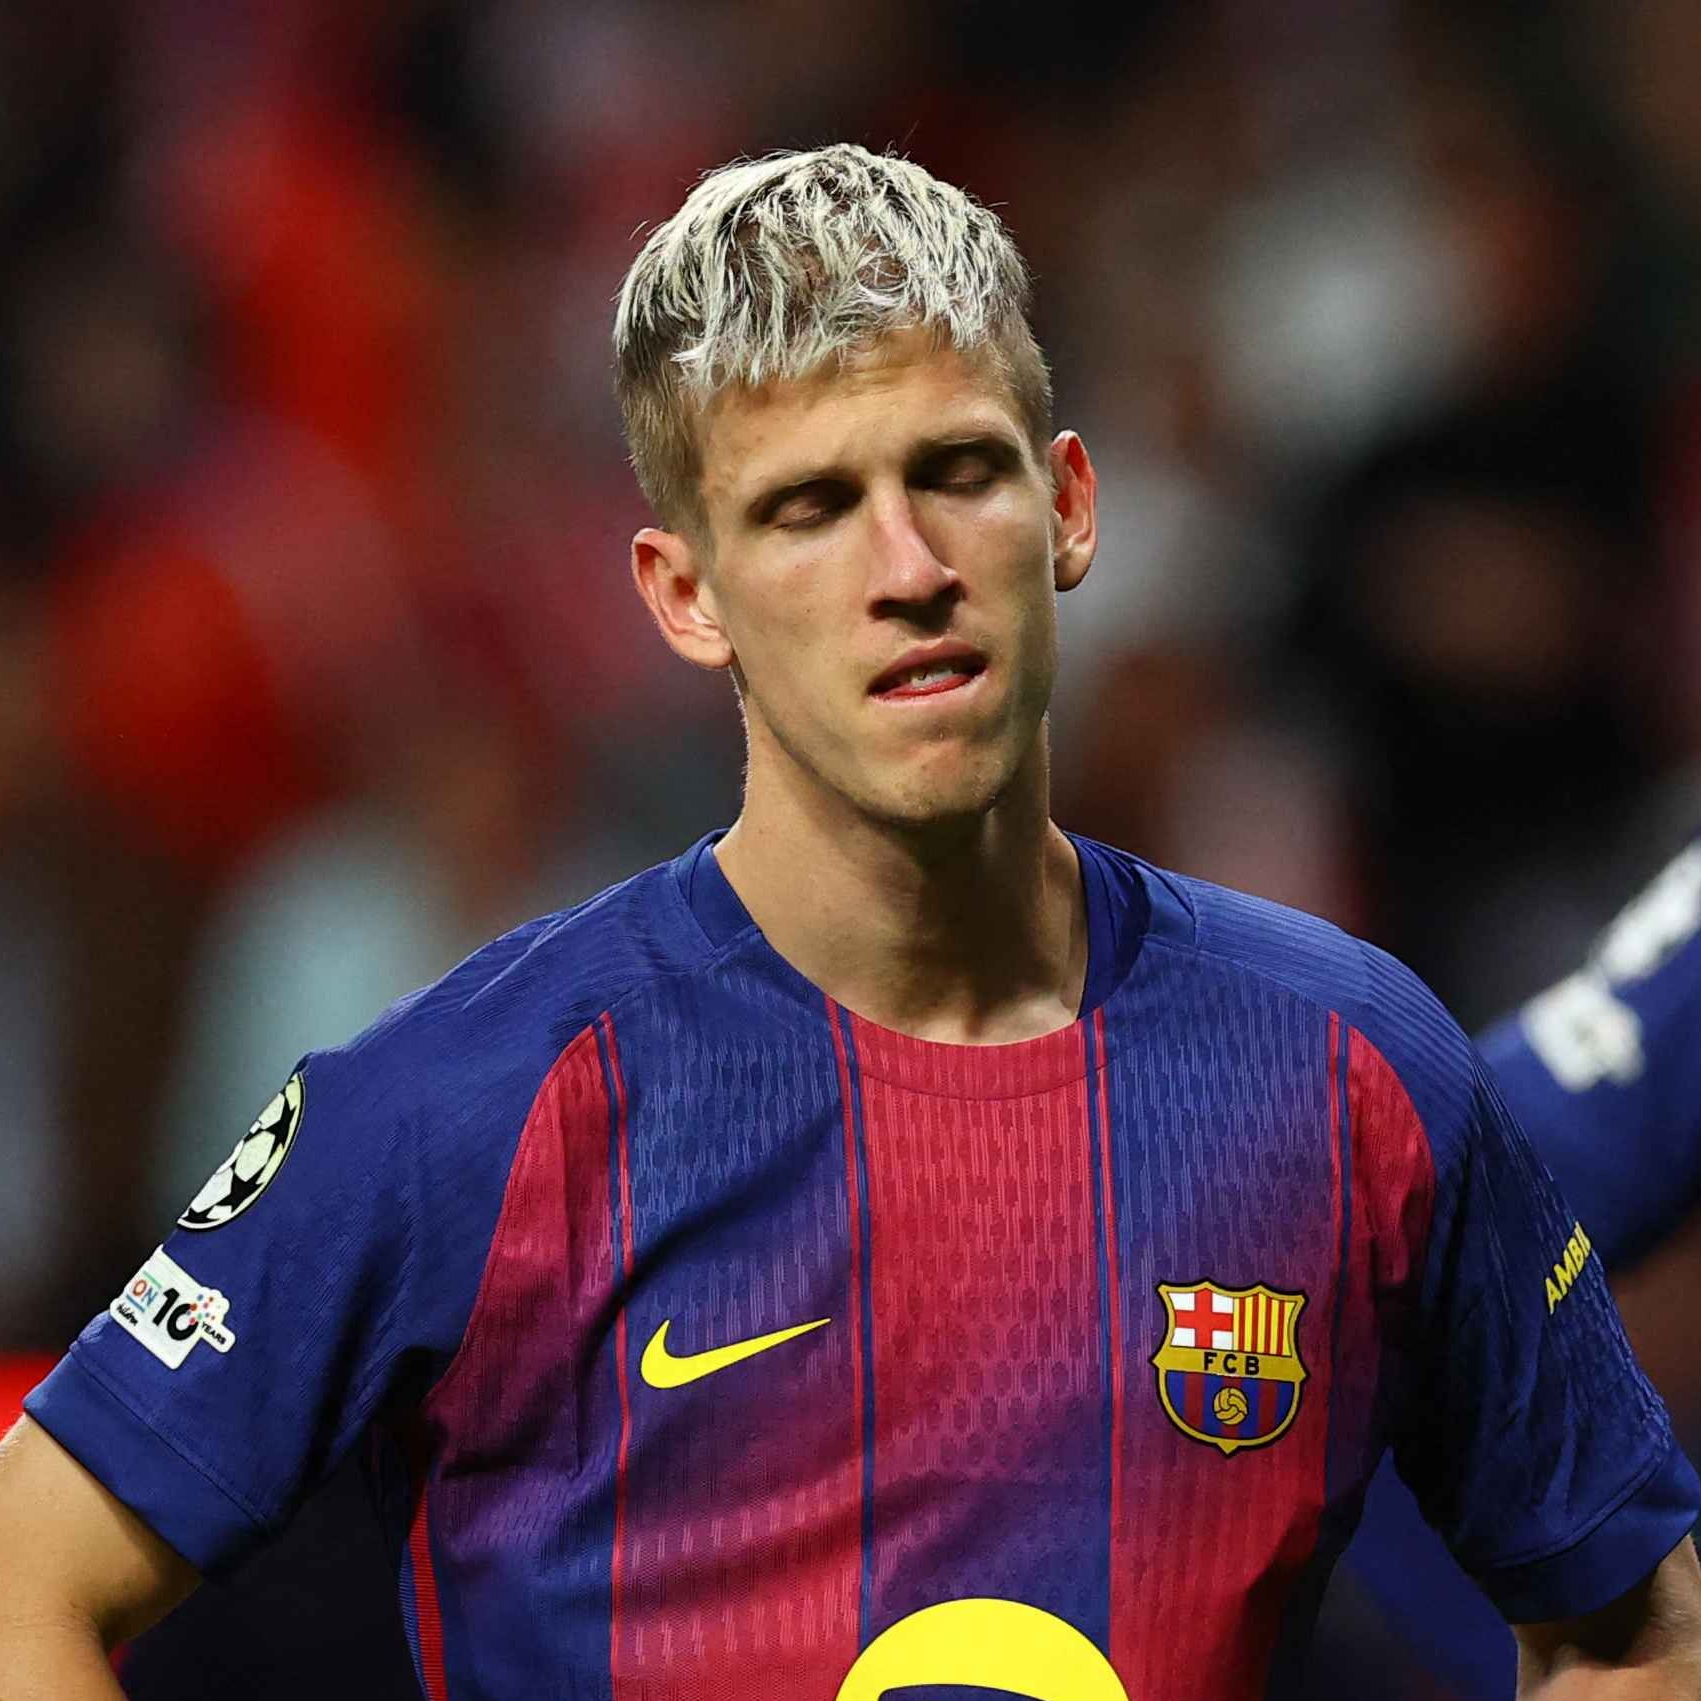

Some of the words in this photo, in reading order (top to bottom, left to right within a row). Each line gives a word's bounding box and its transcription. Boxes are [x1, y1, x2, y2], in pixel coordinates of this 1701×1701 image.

[152, 1287, 199, 1341] 10
[201, 1321, 227, 1345] YEARS
[1203, 1351, 1260, 1376] FCB
